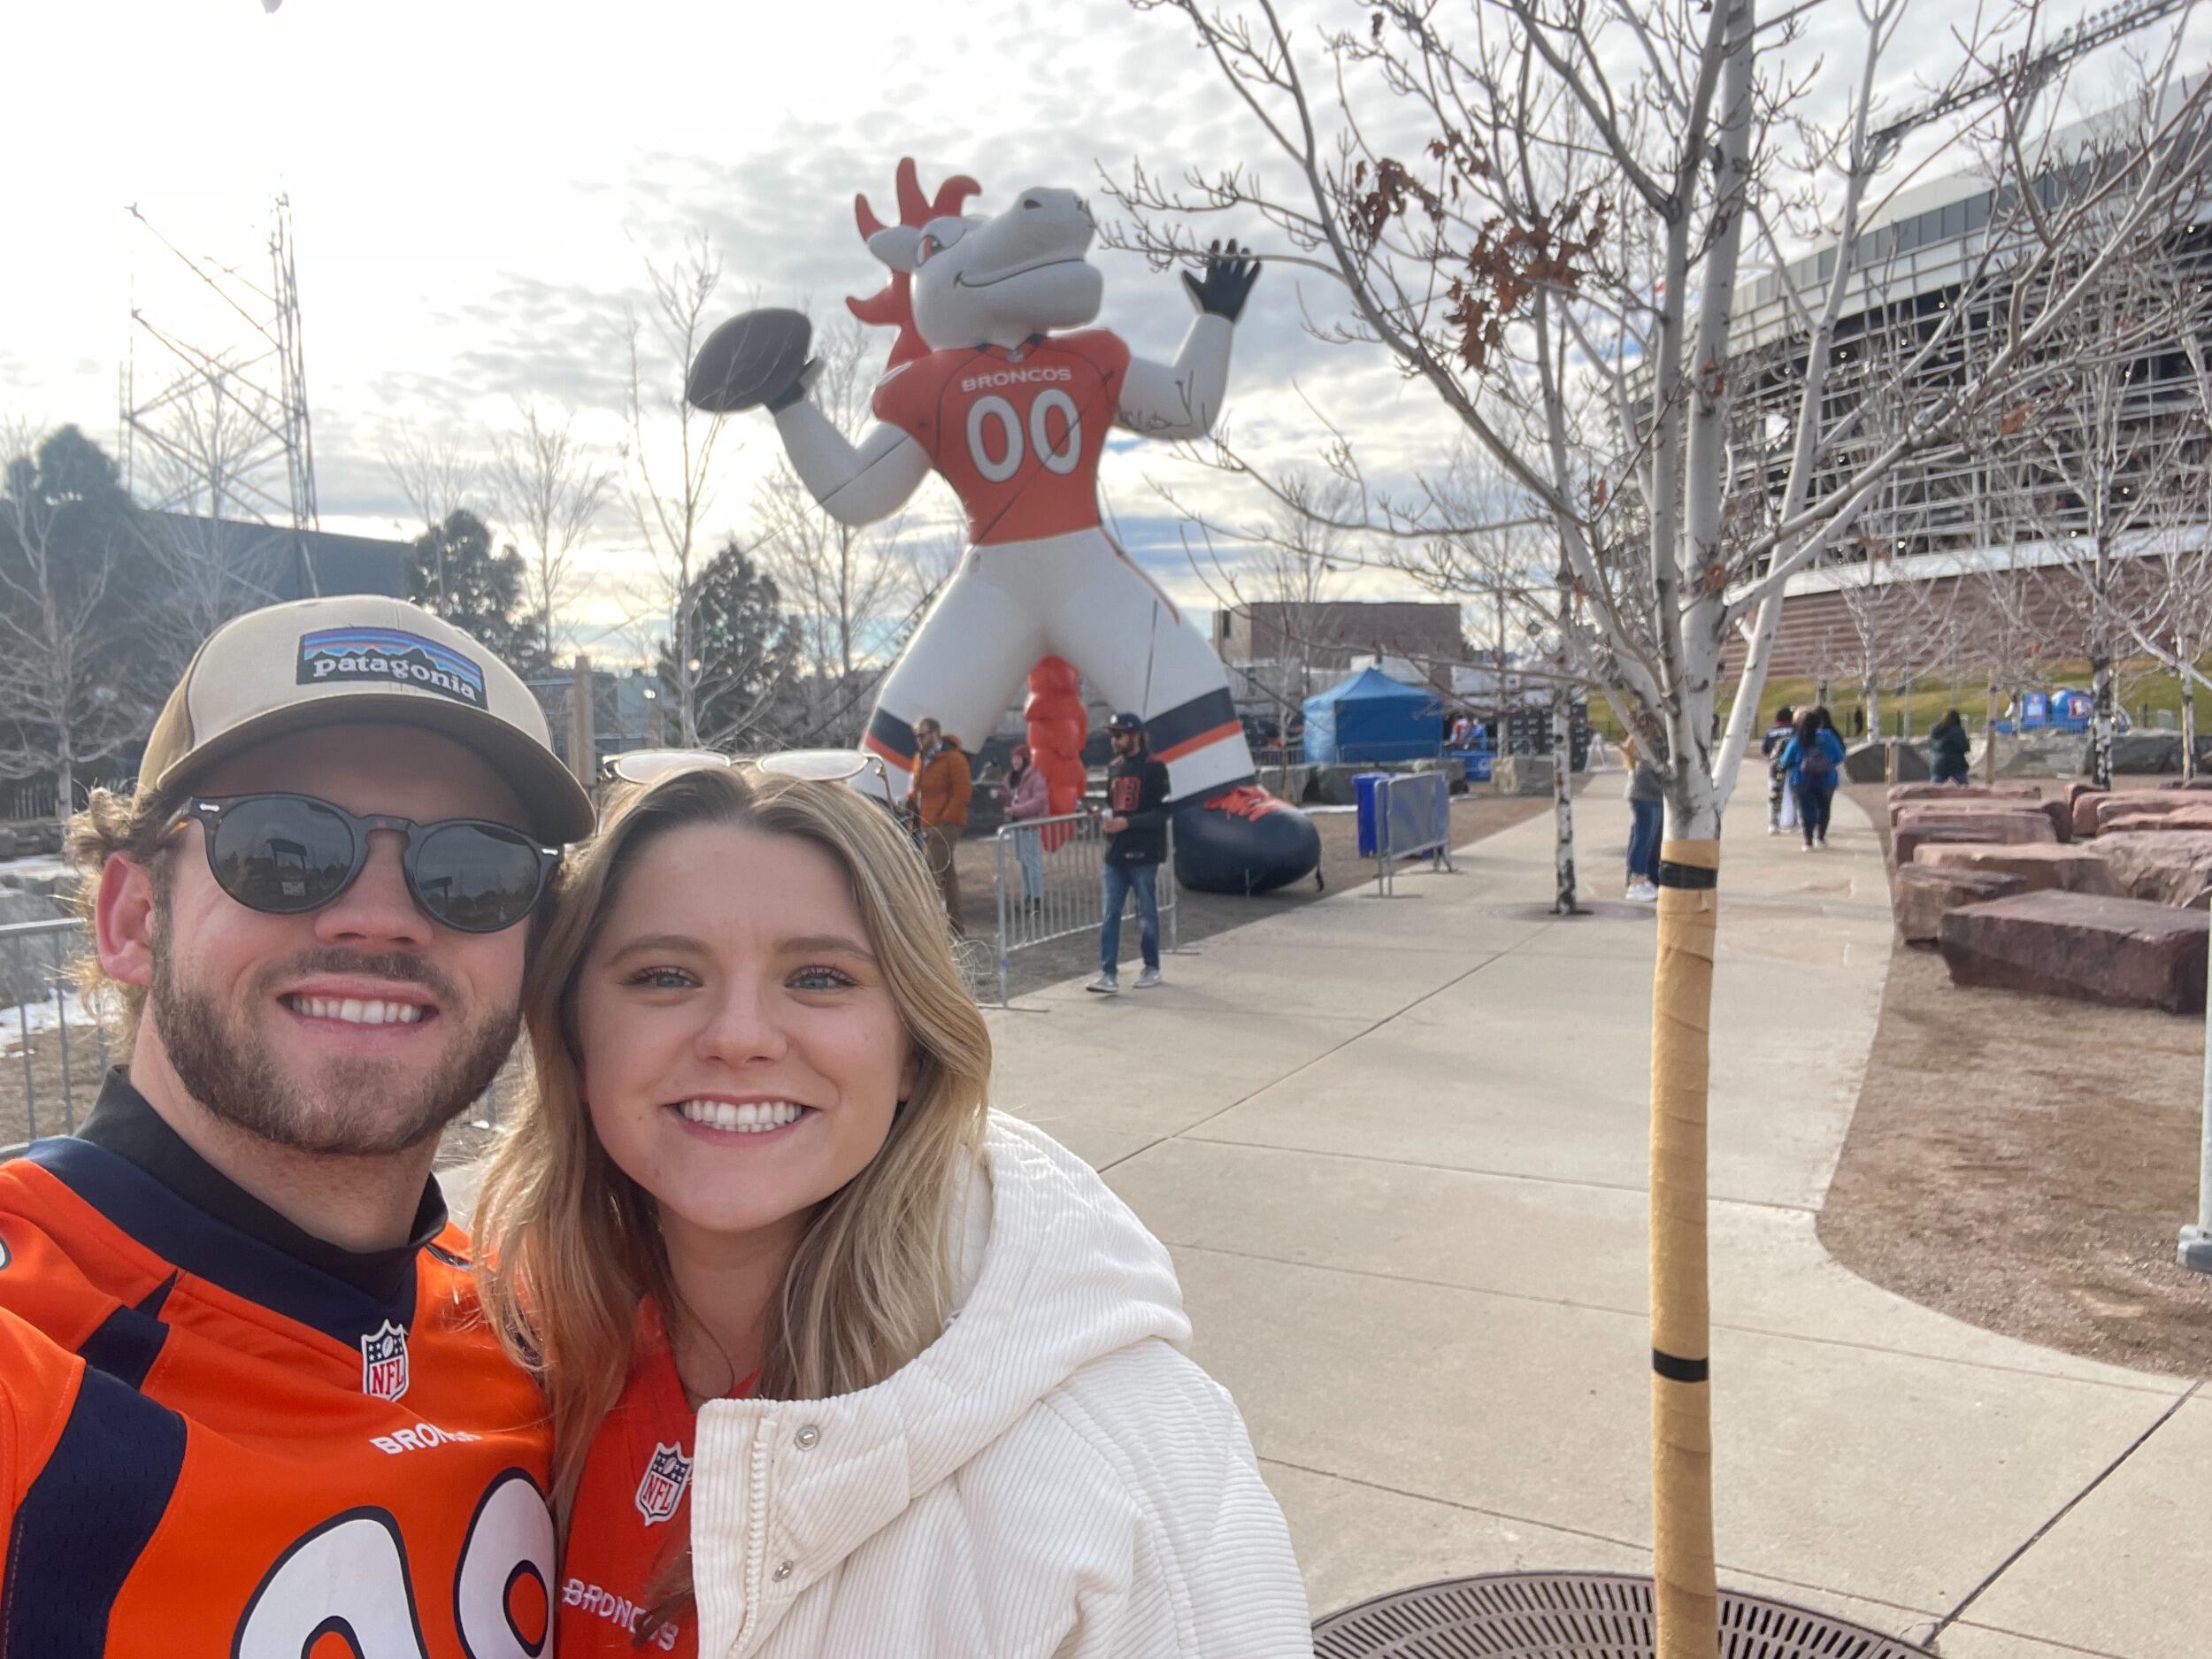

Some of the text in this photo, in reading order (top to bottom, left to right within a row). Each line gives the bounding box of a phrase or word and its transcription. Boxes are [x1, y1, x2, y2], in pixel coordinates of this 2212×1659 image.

[961, 368, 1072, 392] BRONCOS
[965, 387, 1083, 483] 00
[313, 657, 476, 702] patagonia
[372, 1358, 404, 1395] NFL
[368, 1423, 483, 1455] BRON
[642, 1474, 676, 1511] NFL
[562, 1578, 680, 1652] BRONCS
